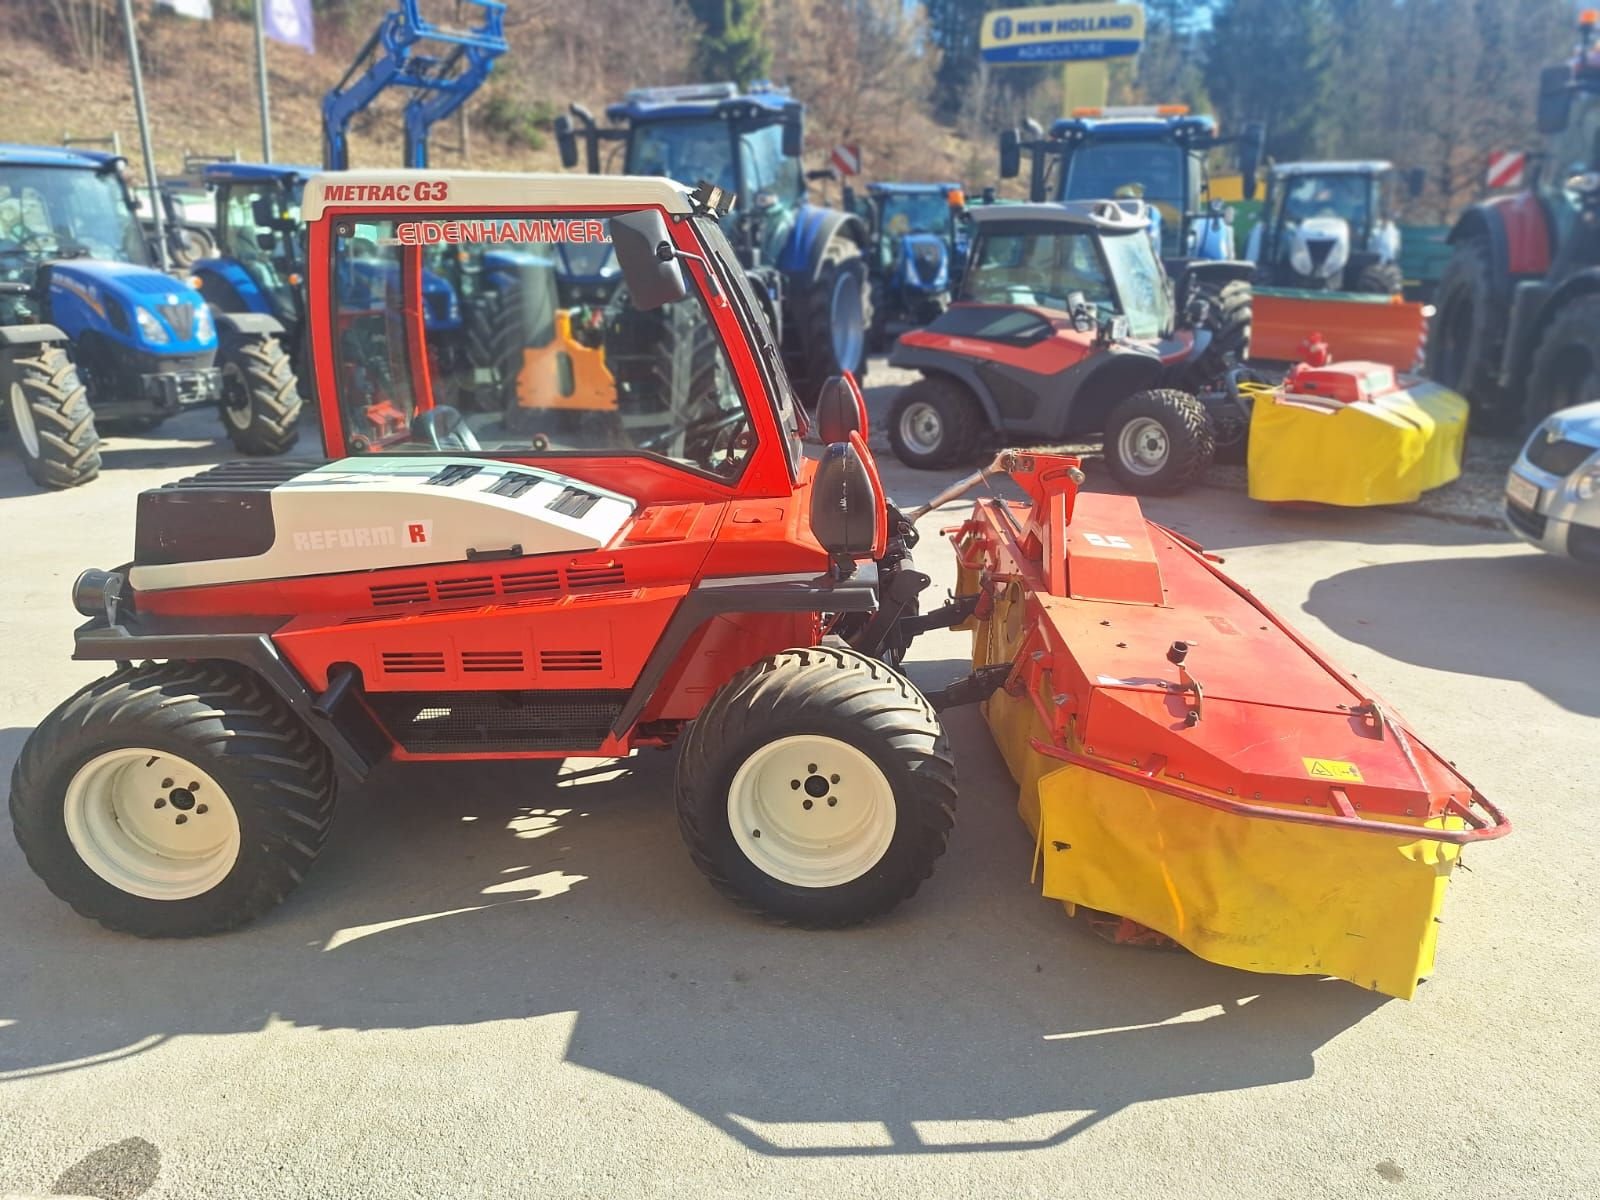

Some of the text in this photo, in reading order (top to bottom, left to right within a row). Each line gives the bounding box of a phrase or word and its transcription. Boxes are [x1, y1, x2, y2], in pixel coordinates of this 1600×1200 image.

[1016, 15, 1133, 35] NEW HOLLAND
[324, 181, 448, 201] METRAC G3
[293, 524, 426, 550] REFORM R
